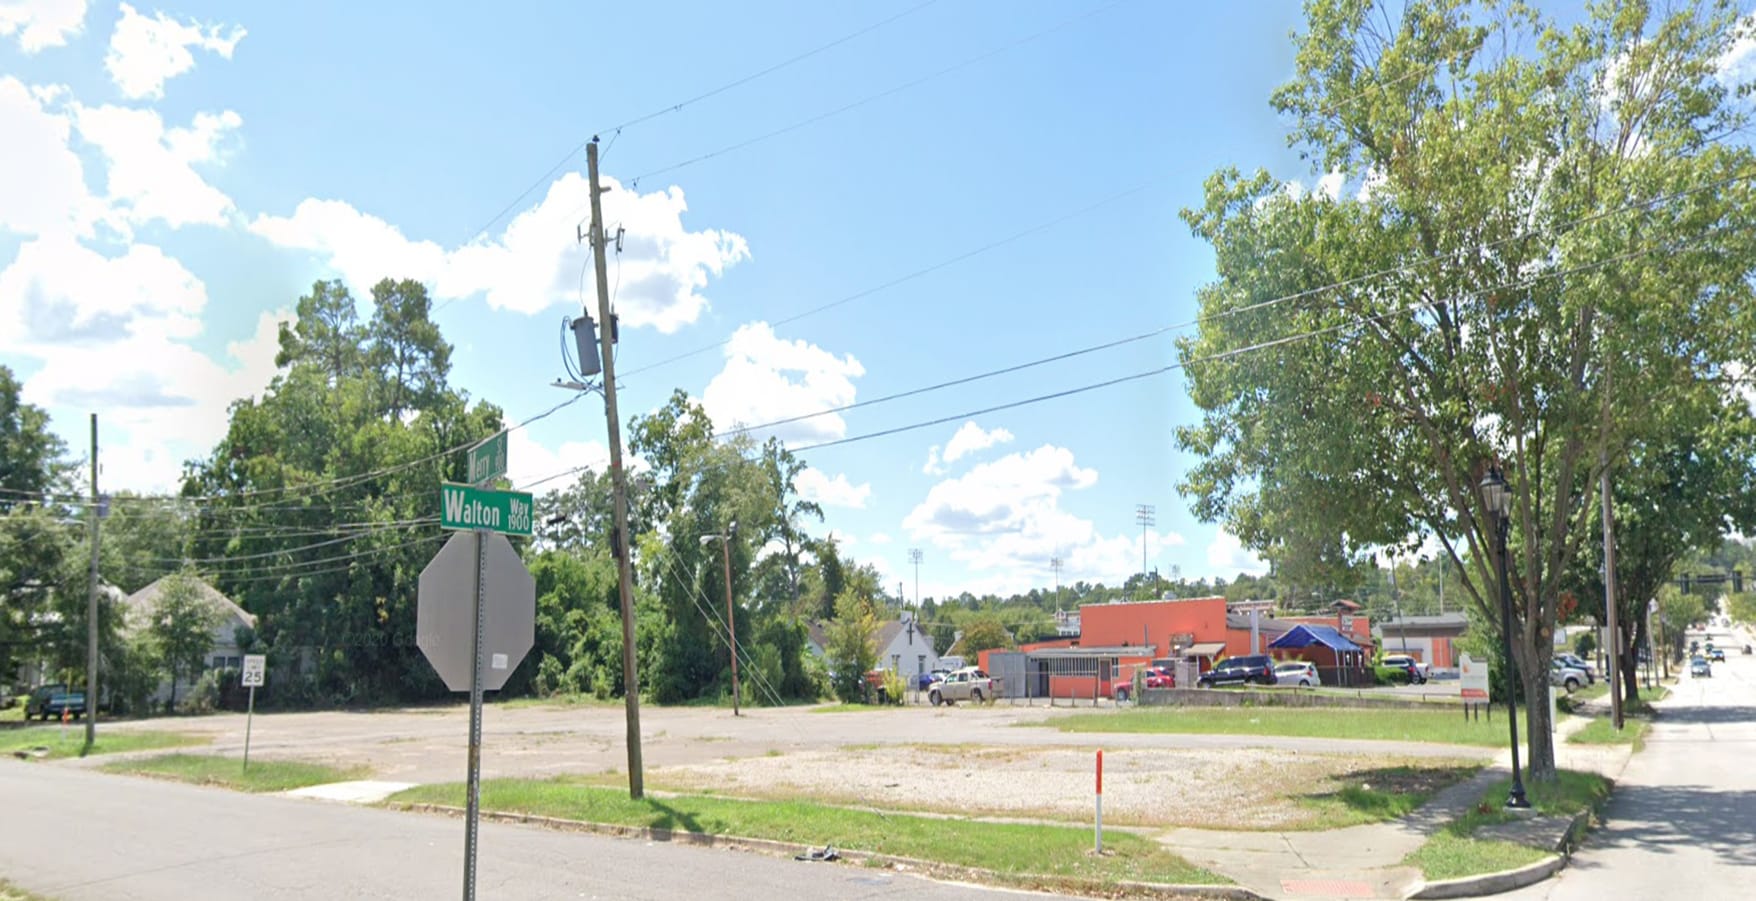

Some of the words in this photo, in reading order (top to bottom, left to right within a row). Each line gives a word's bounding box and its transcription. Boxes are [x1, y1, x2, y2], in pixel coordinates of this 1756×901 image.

[468, 451, 490, 483] Merry
[444, 489, 500, 527] Walton
[510, 498, 529, 515] Way
[508, 513, 529, 531] 1900
[244, 671, 262, 683] 25
